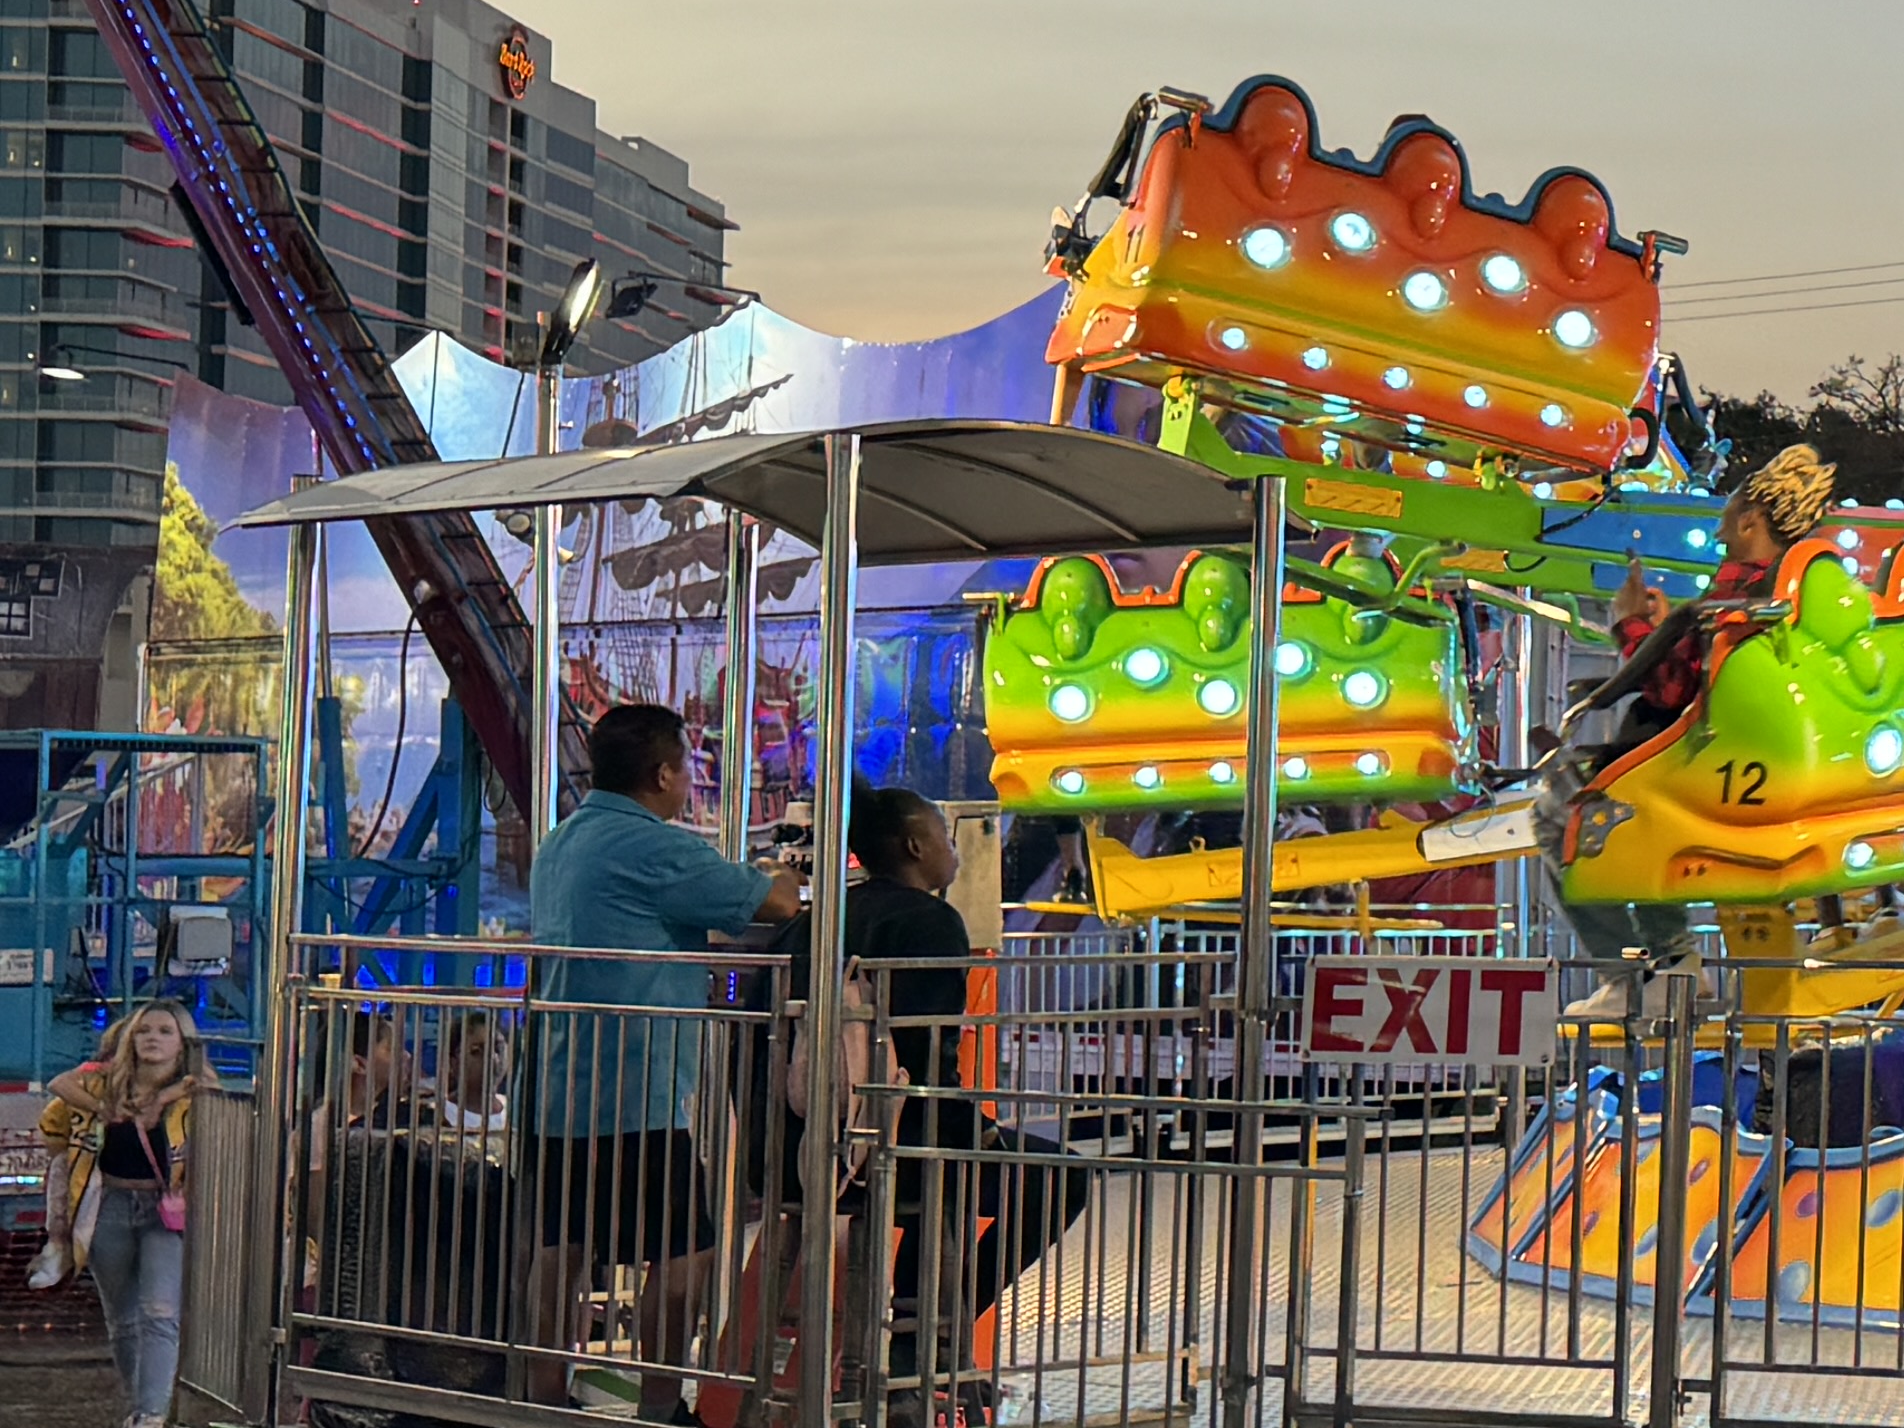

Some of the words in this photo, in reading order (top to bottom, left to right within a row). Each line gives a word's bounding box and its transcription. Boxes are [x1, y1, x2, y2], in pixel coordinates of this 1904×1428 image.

[1124, 223, 1146, 264] 11
[1715, 759, 1768, 805] 12
[1310, 967, 1546, 1056] EXIT
